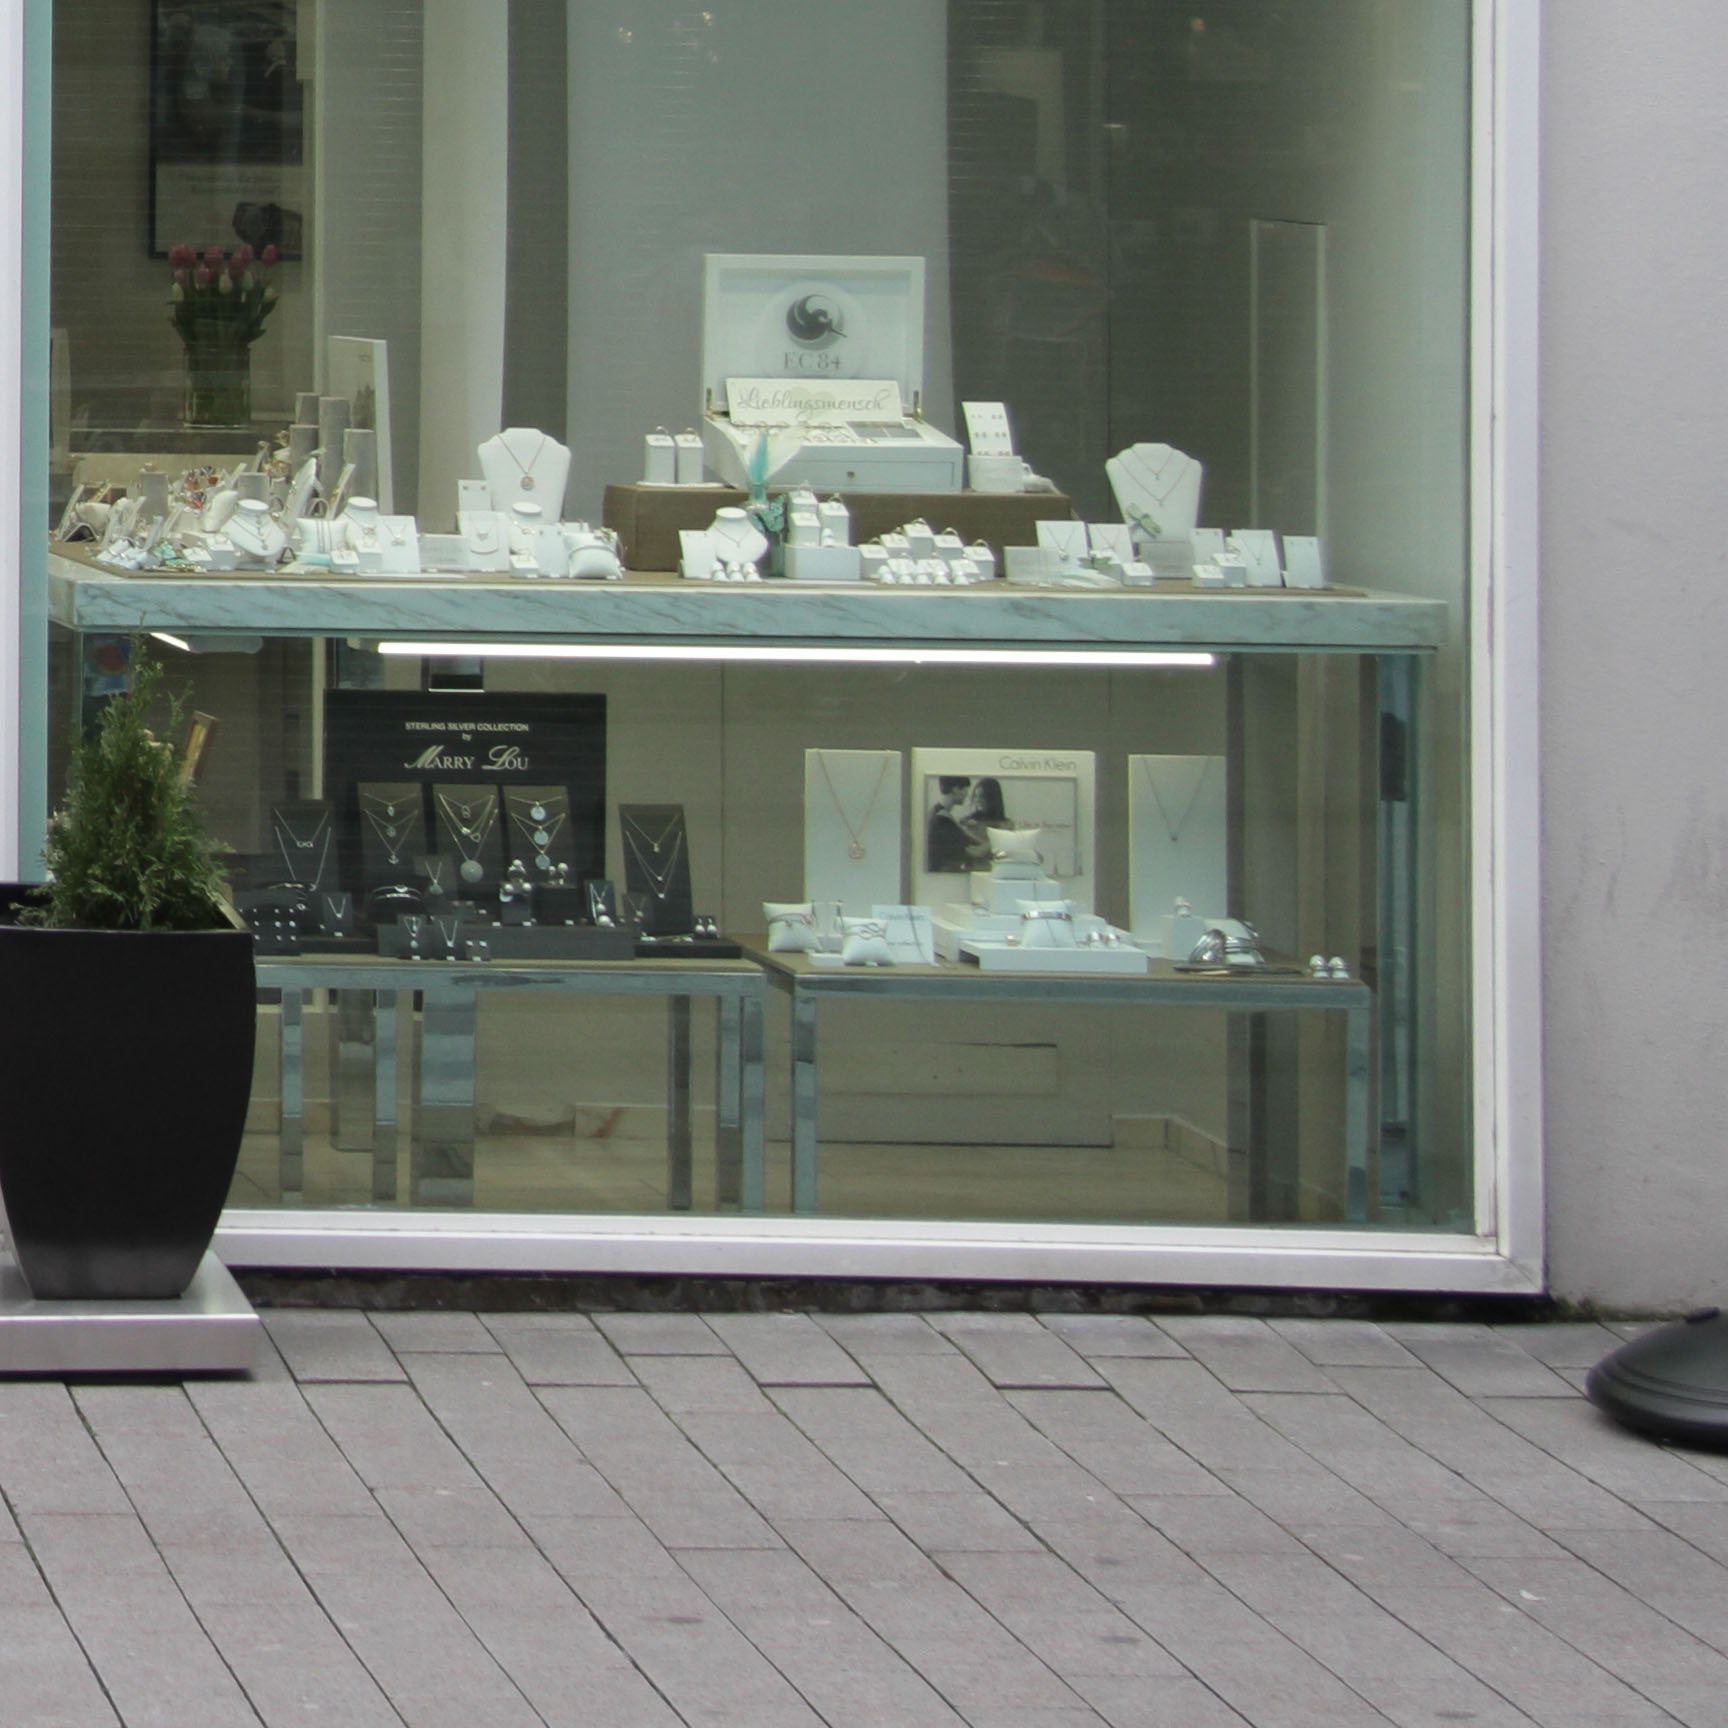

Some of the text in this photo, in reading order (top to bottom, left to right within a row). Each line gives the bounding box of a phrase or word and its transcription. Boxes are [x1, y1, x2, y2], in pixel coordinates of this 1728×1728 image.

[737, 386, 890, 420] Lieblingsmensch
[404, 721, 446, 731] STERLING
[477, 722, 529, 732] COLLECTION
[404, 744, 529, 770] MARRY LOU
[999, 756, 1077, 771] Calvin Klein
